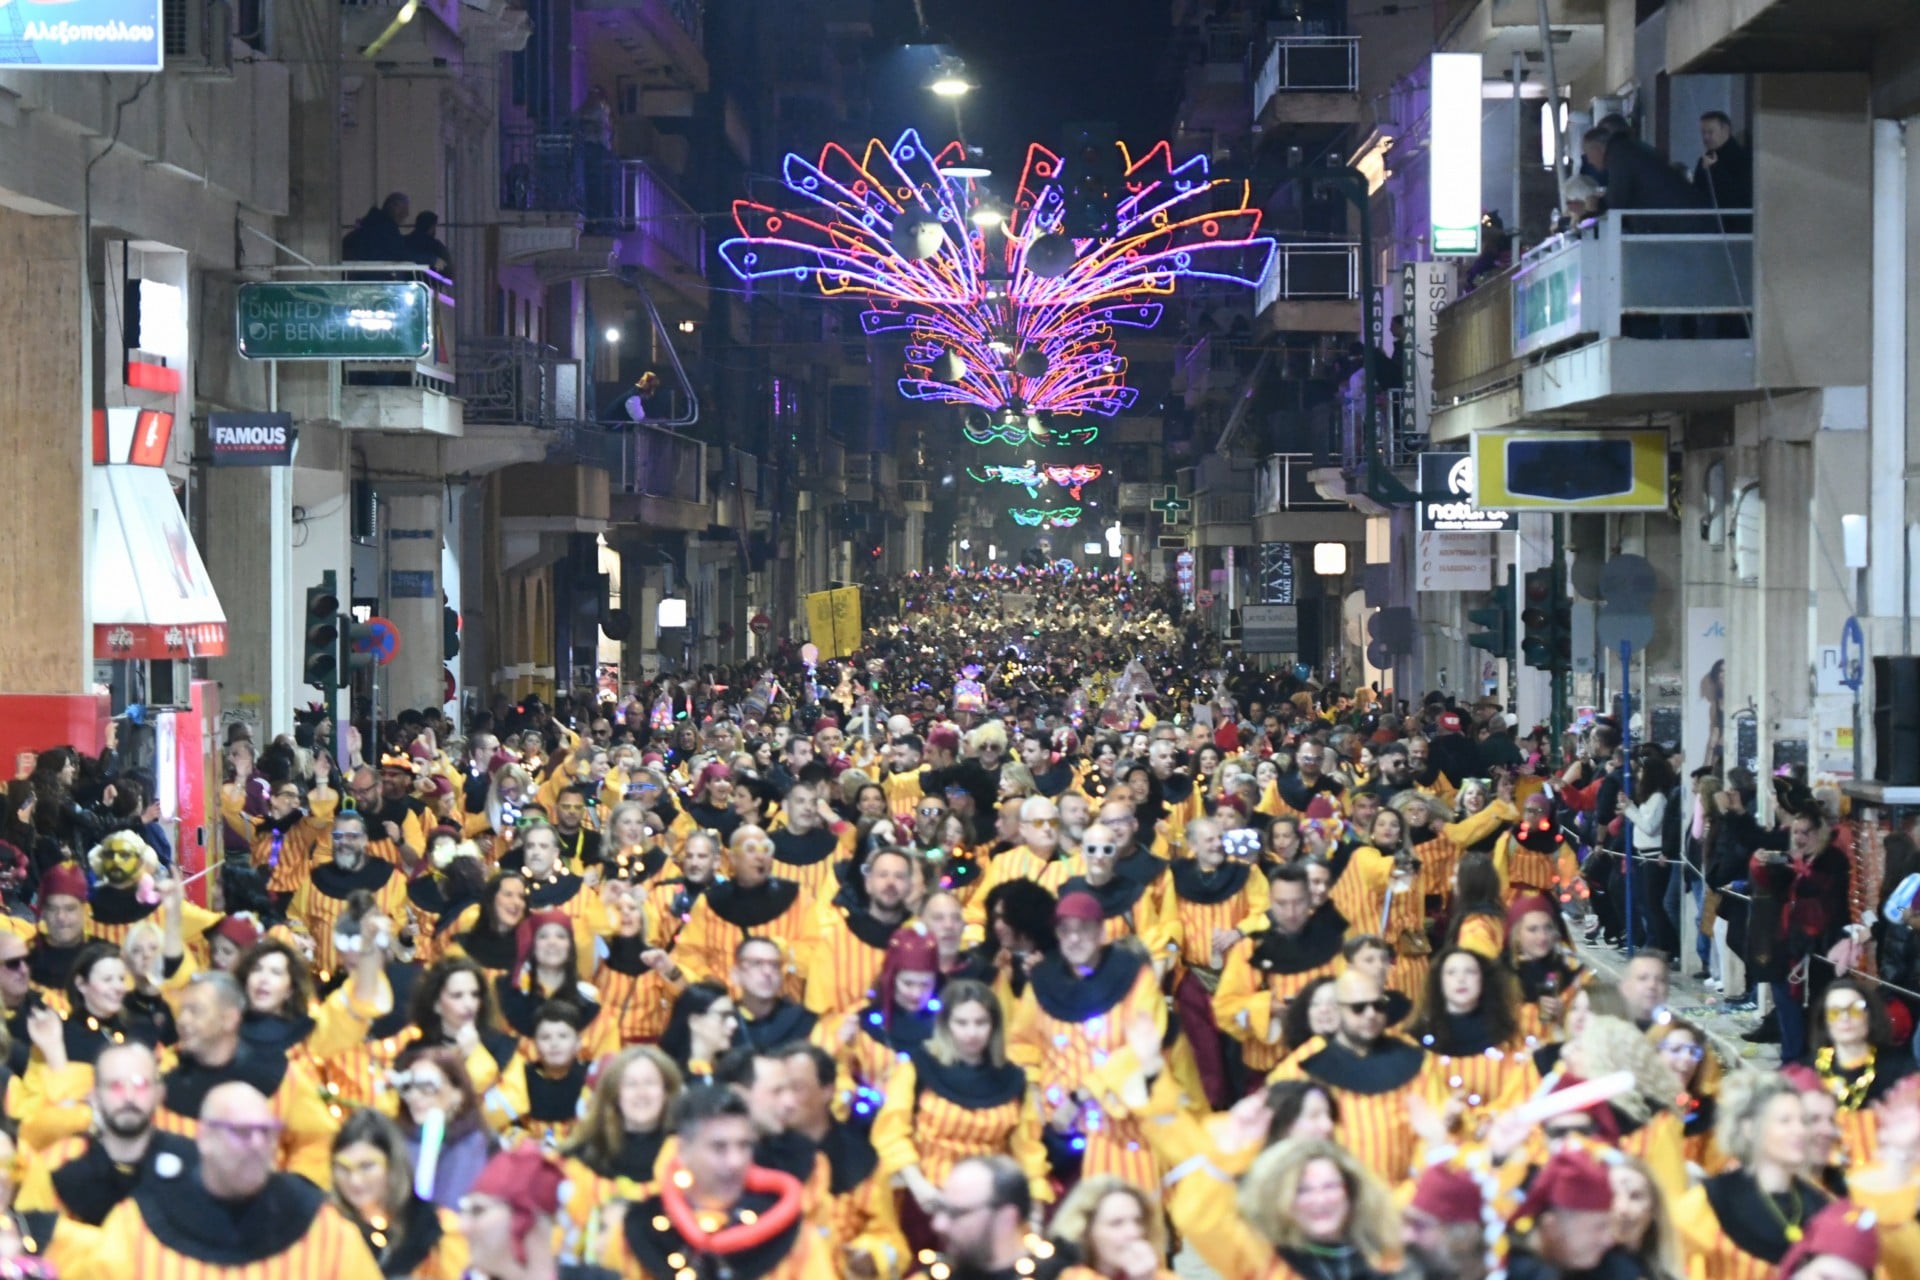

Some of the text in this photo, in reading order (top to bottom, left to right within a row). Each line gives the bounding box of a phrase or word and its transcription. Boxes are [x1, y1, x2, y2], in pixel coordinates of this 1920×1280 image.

[23, 19, 155, 46] Αλεξοπούλου
[249, 301, 321, 320] UNITED
[249, 322, 279, 341] OF
[1403, 266, 1416, 426] ΑΔΥΝΑΤΙΣΜΑ
[216, 427, 286, 445] FAMOUS
[1283, 562, 1292, 575] UP
[1283, 578, 1292, 604] MAKE
